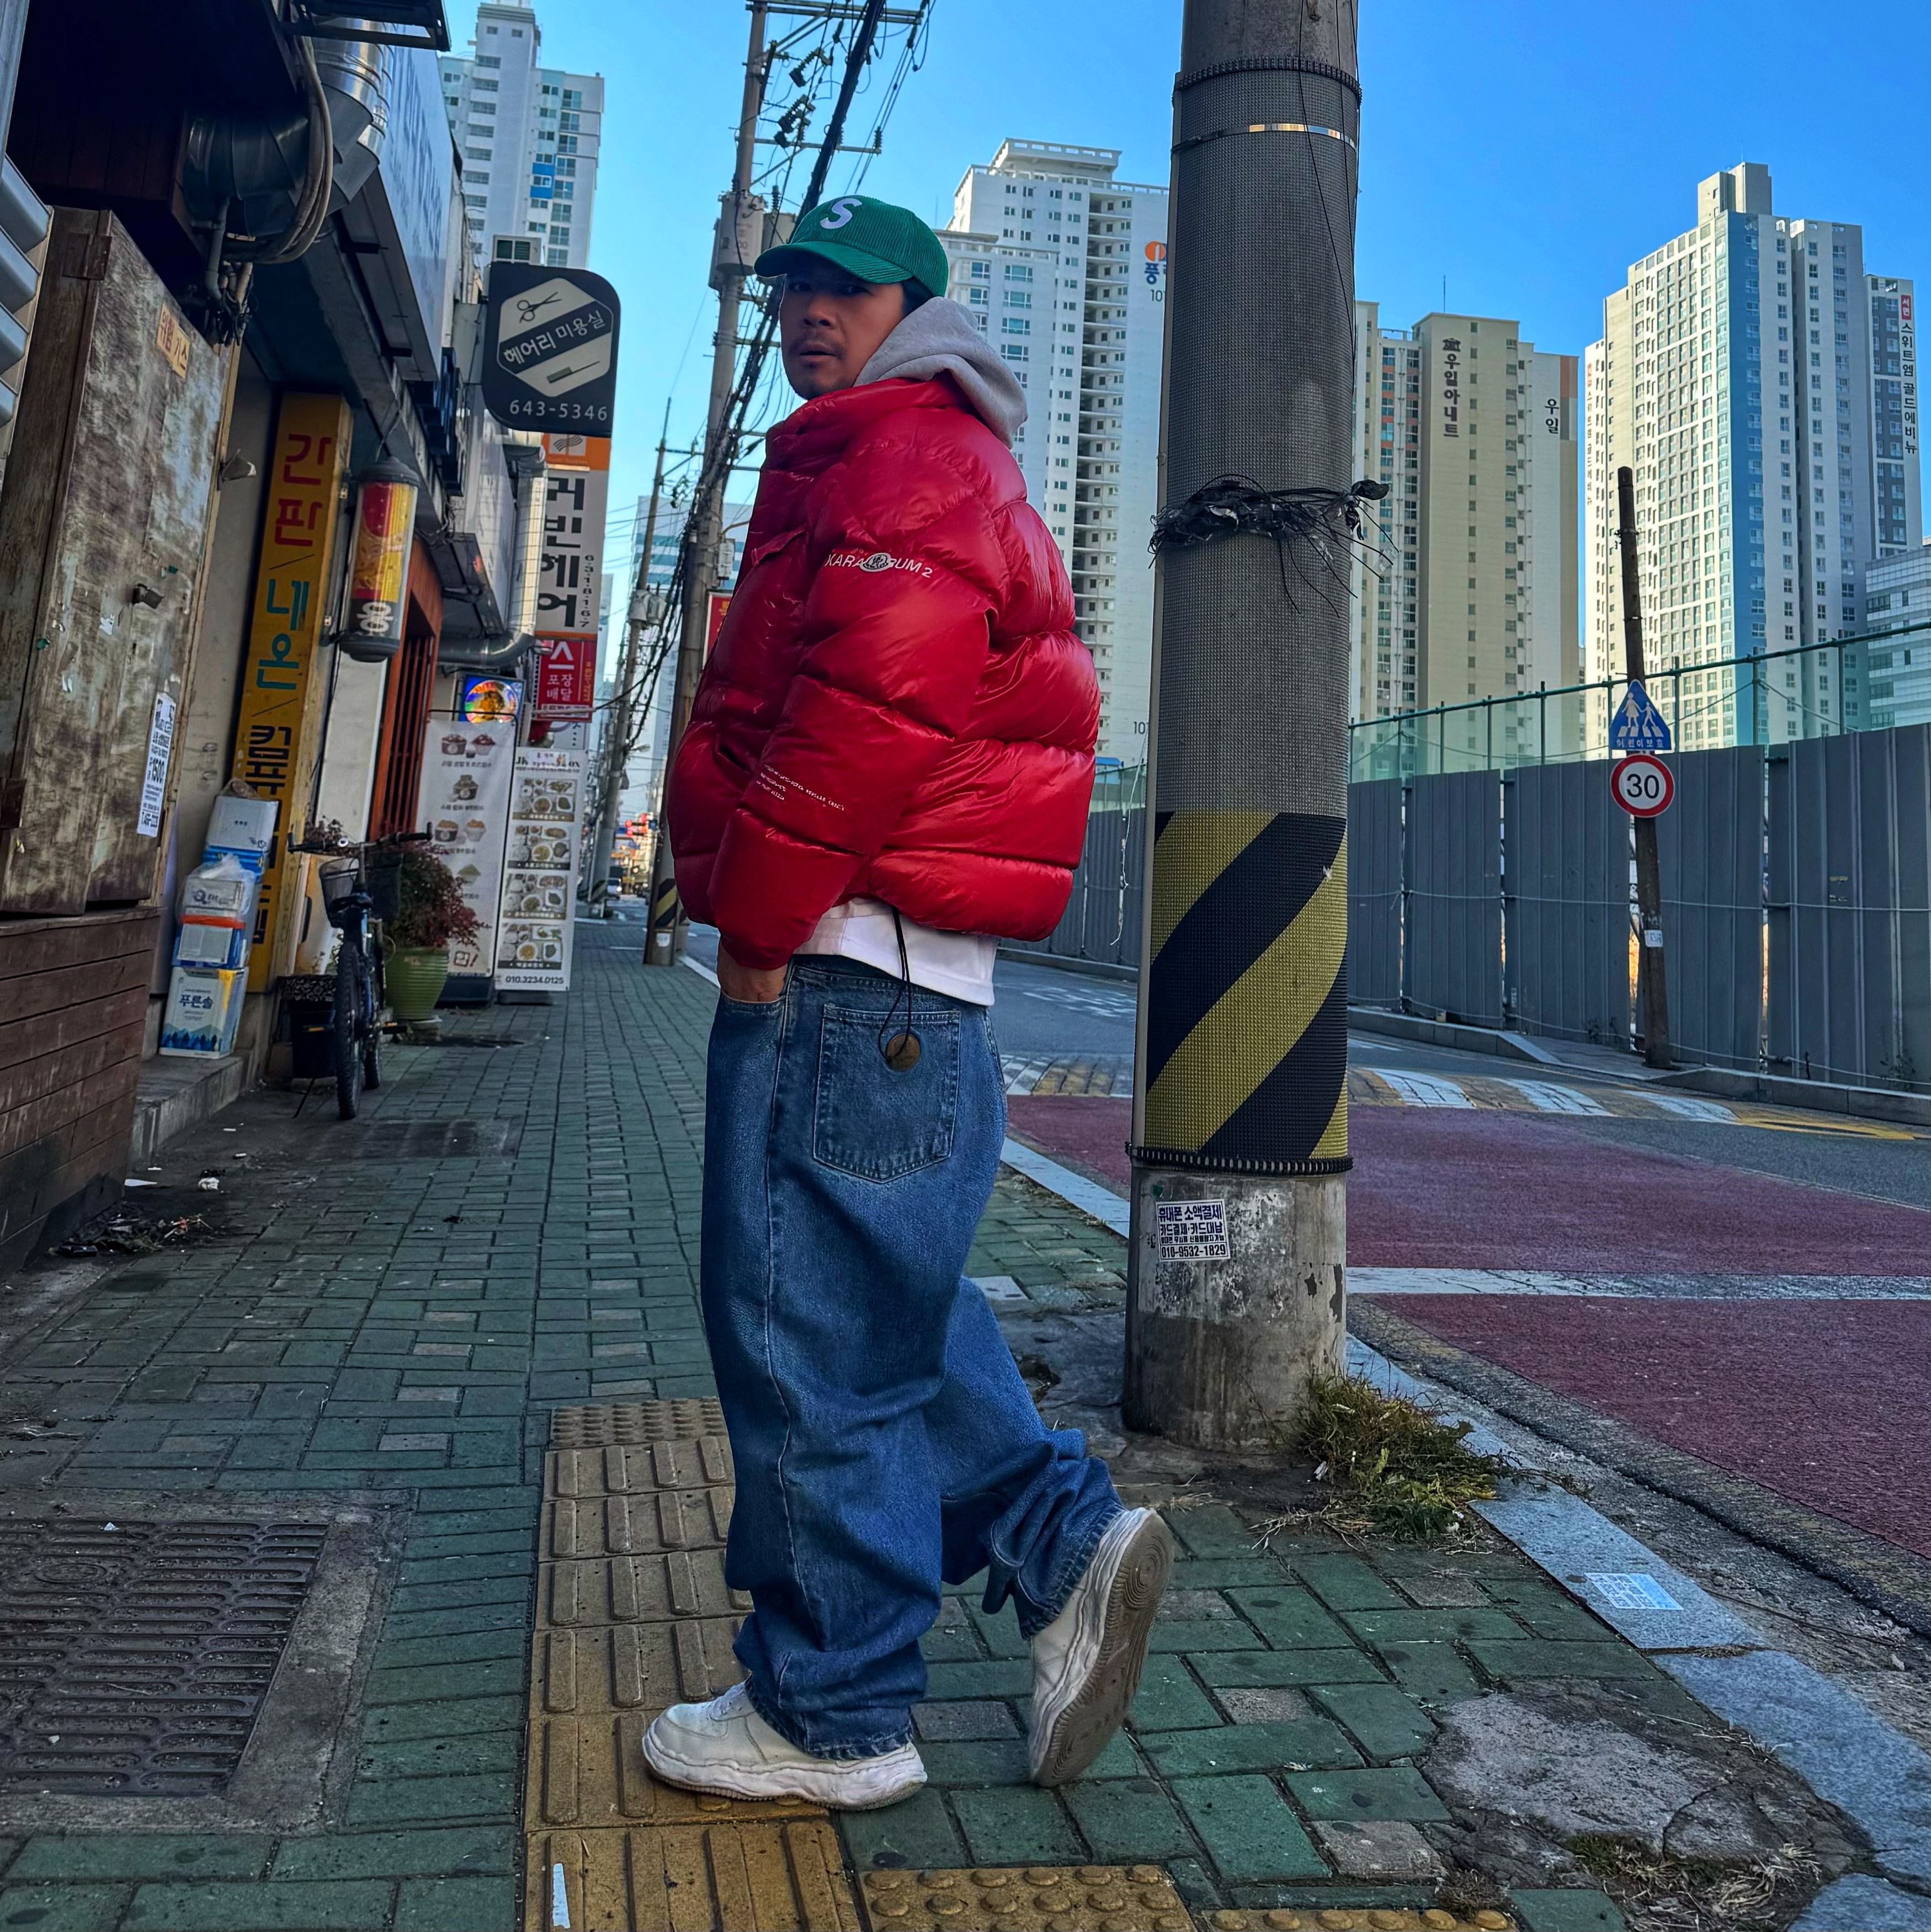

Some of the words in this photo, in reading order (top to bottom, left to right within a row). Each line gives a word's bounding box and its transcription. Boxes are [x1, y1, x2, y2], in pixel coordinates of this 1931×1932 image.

[820, 198, 863, 229] S
[1150, 289, 1166, 302] 10
[503, 332, 556, 364] 헤어리
[556, 310, 605, 338] 미용실
[509, 400, 607, 421] 643-5346
[1545, 398, 1560, 434] 우일
[274, 433, 332, 547] 간판
[547, 673, 573, 687] 포장
[1133, 721, 1149, 735] 10
[1626, 774, 1659, 799] 30
[1159, 1206, 1183, 1222] 휴대폰
[1184, 1204, 1222, 1221] 소액결제
[1161, 1244, 1226, 1258] 010-9532-1829
